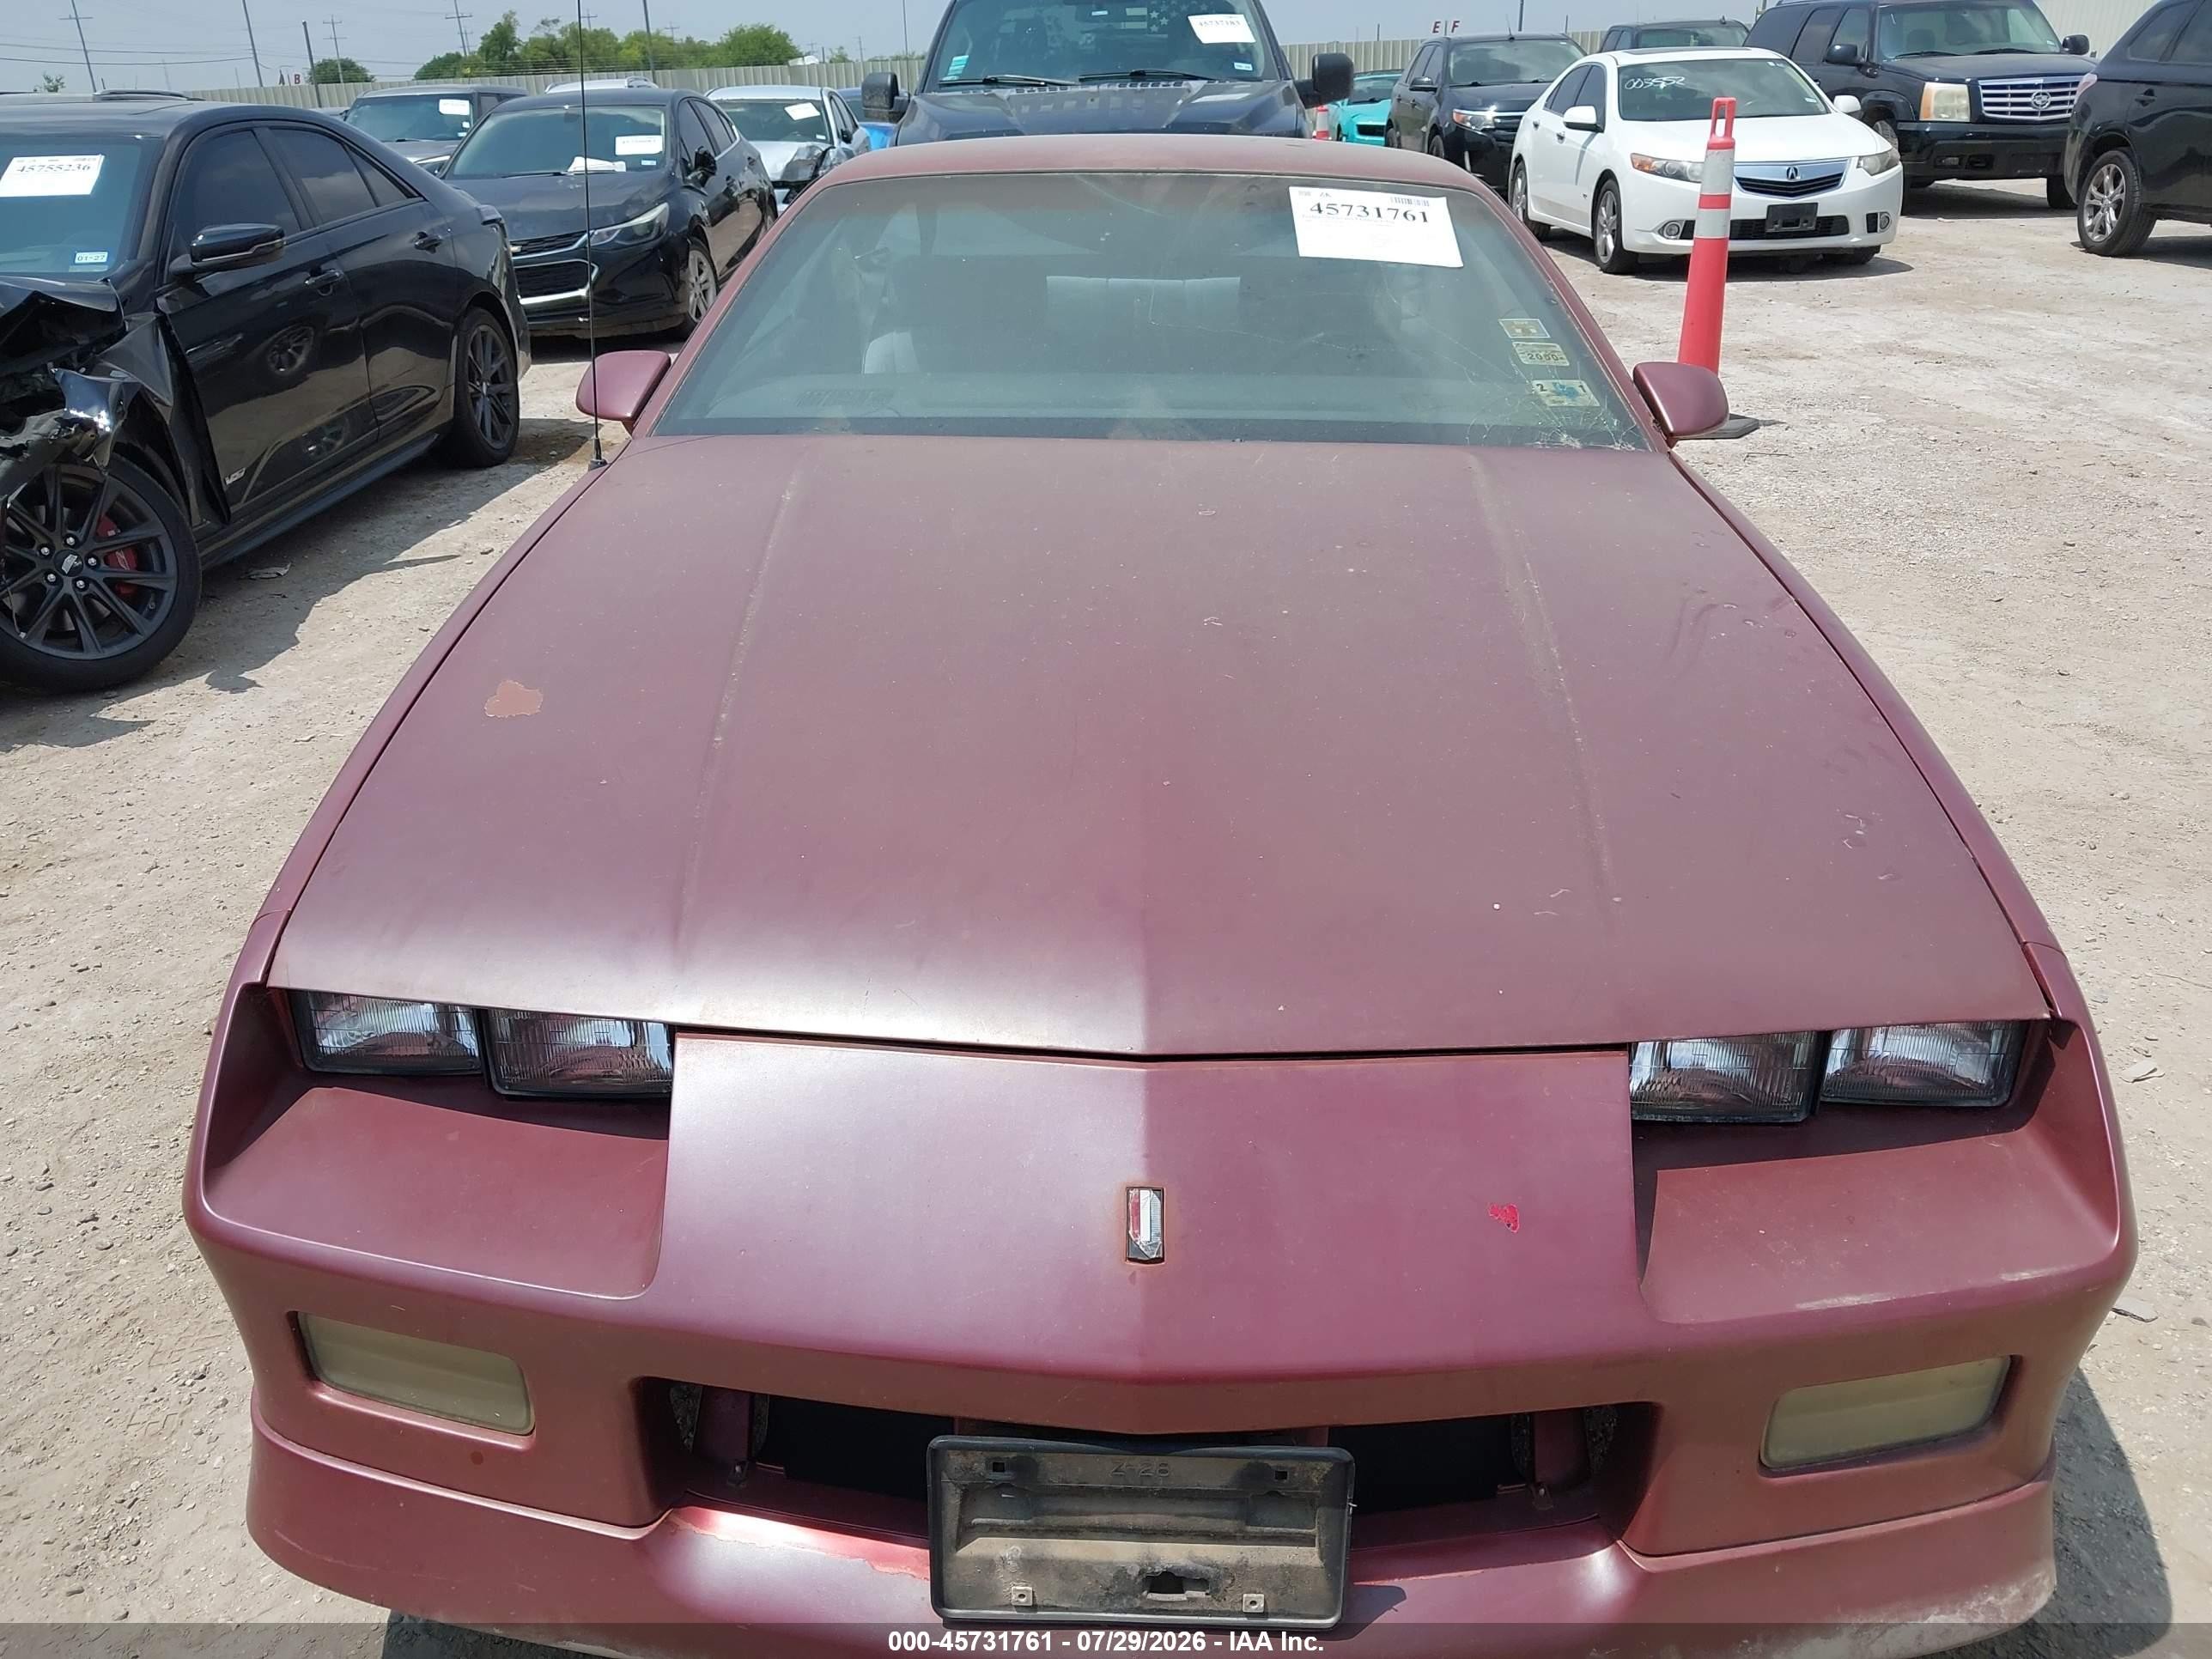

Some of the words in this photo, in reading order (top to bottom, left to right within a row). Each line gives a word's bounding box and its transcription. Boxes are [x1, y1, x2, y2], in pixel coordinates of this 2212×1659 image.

[1432, 21, 1442, 33] E
[1451, 20, 1461, 33] F
[294, 74, 301, 85] B
[16, 163, 91, 173] 45755236
[1310, 202, 1429, 223] 45731761
[1535, 382, 1547, 392] 2
[1578, 384, 1587, 393] 1
[1111, 1462, 1170, 1477] Z-28
